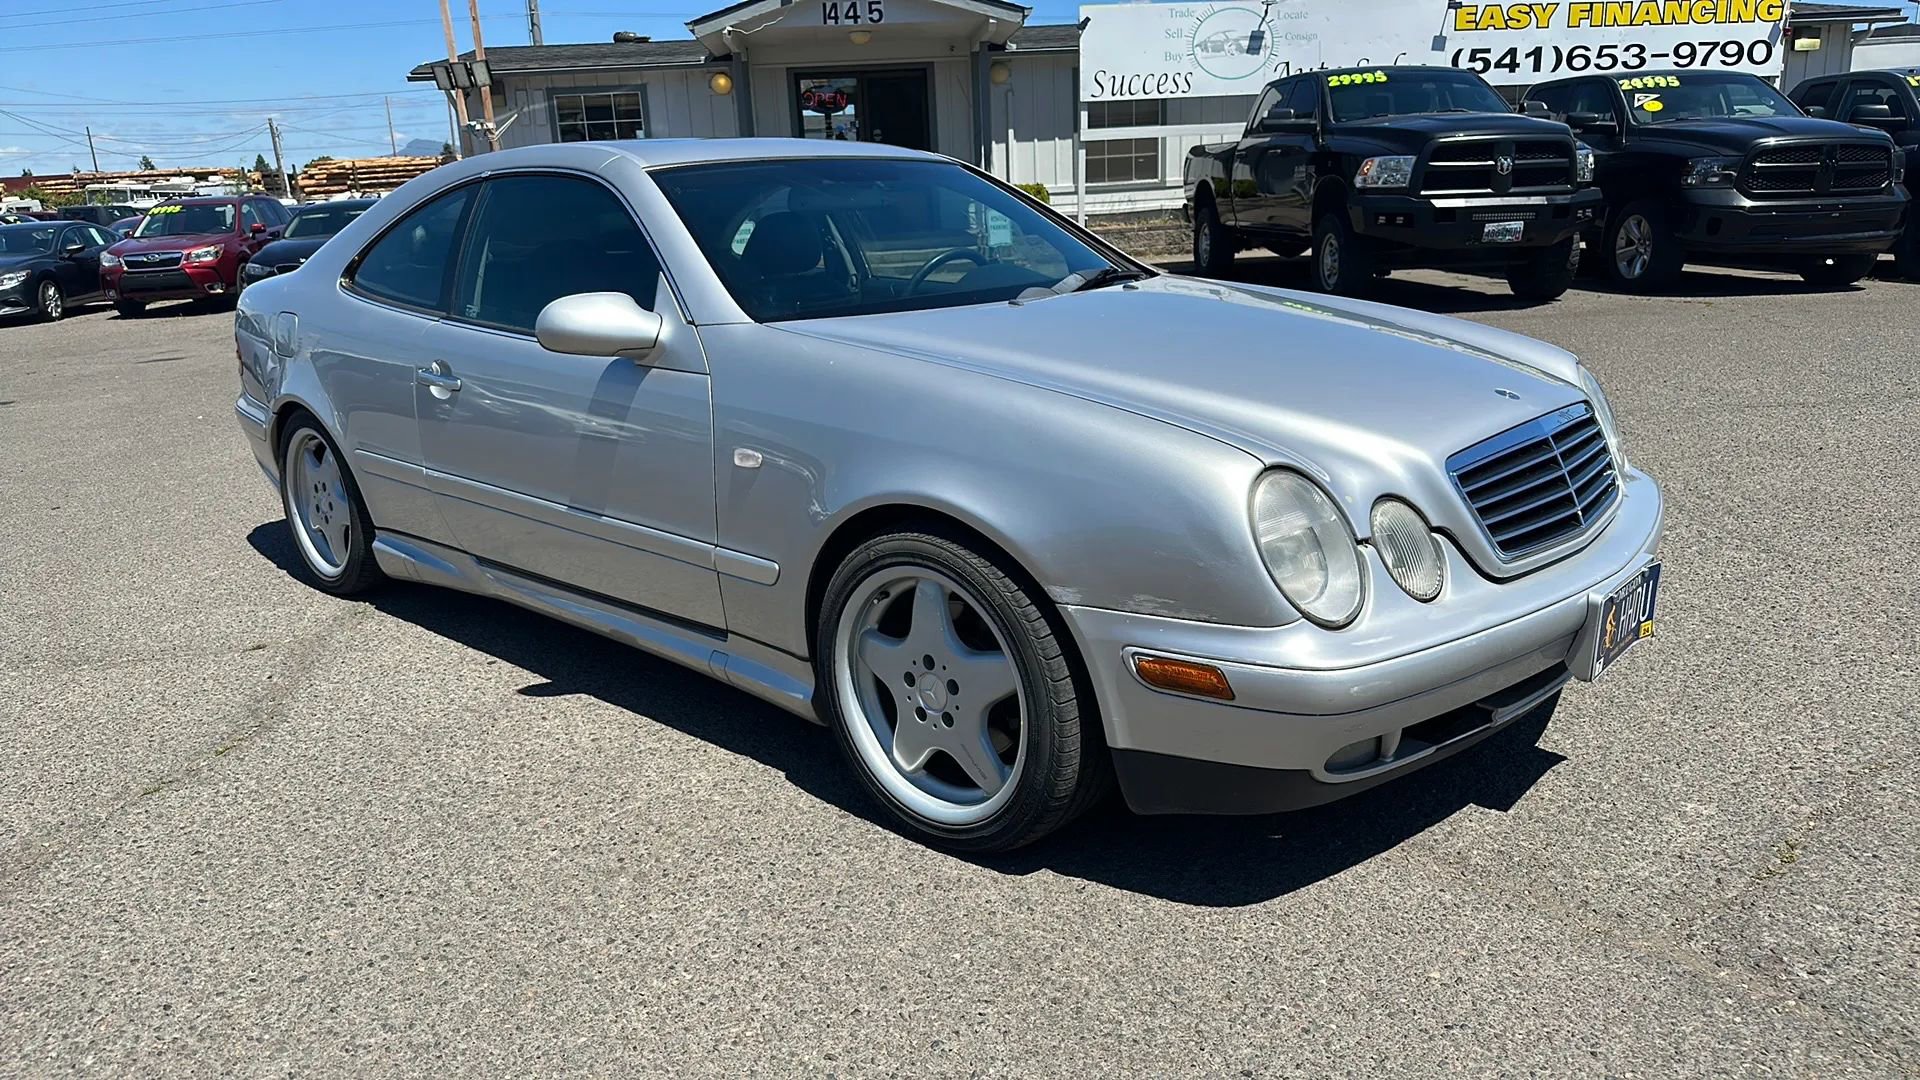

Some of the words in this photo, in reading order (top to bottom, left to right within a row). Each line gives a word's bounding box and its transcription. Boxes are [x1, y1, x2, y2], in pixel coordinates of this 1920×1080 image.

[822, 1, 883, 25] 1445
[1168, 8, 1195, 18] Trade
[1277, 10, 1309, 20] Locate
[1454, 3, 1560, 31] EASY
[1567, 0, 1785, 27] FINANCING
[1165, 29, 1183, 39] Sell
[1285, 32, 1318, 42] Consign
[1165, 52, 1183, 63] Buy
[1451, 39, 1773, 75] (541)653-9790
[1091, 69, 1193, 98] Success
[1327, 70, 1388, 87] 29995
[803, 92, 847, 108] OPEN
